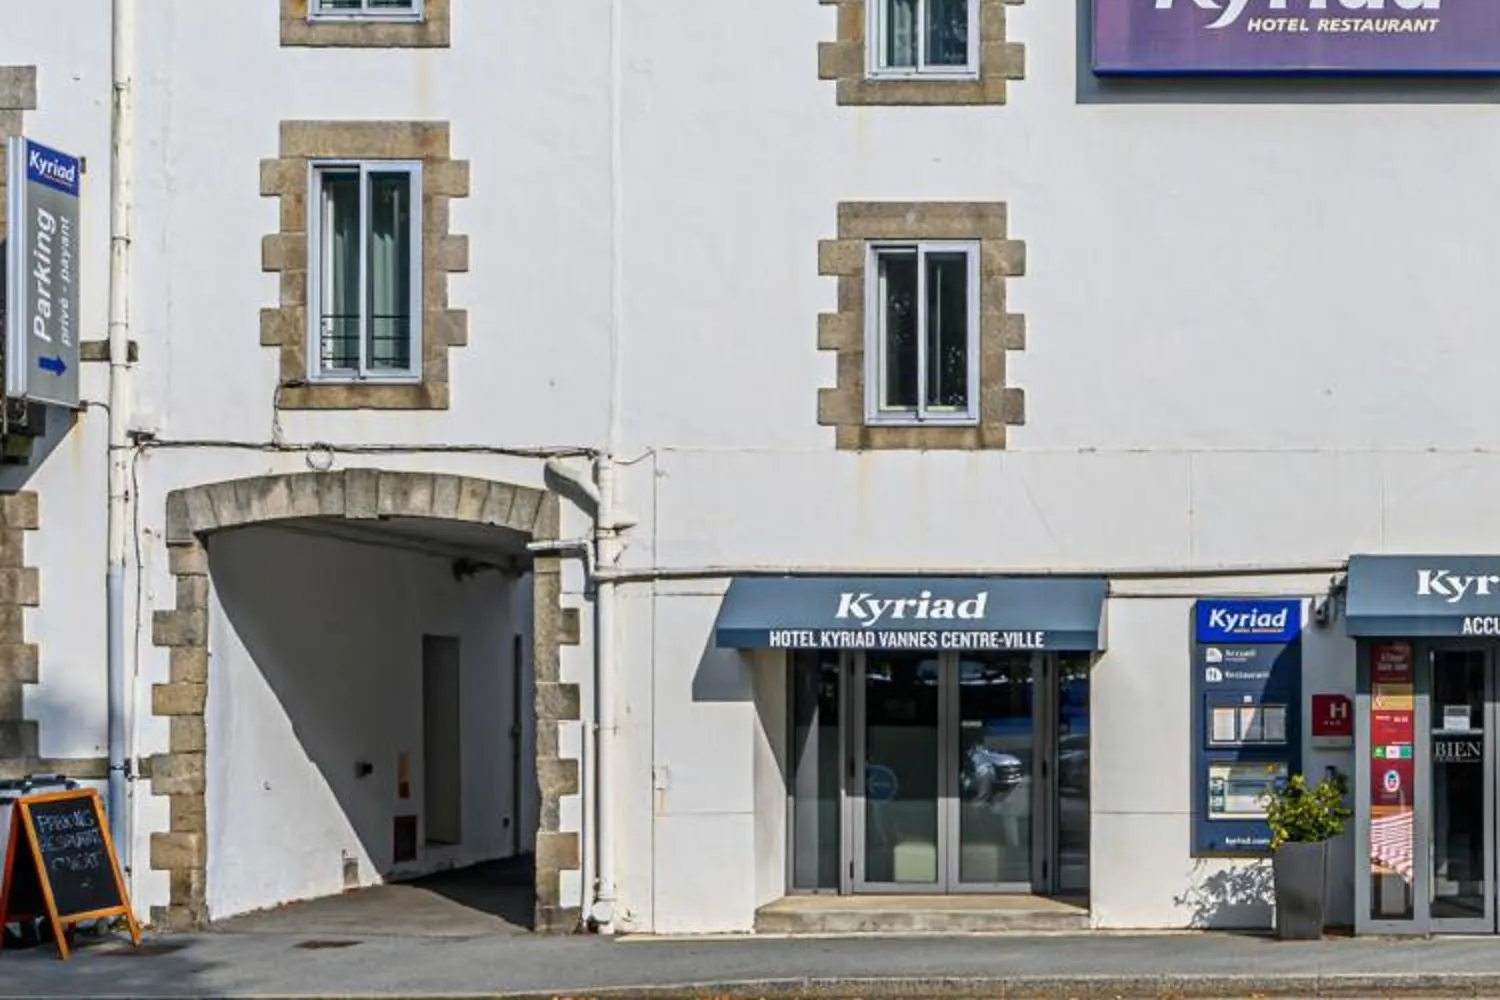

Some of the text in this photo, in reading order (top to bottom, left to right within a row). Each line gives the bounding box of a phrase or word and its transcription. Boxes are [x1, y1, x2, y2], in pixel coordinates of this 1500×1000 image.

[1247, 18, 1440, 33] HOTEL RESTAURANT
[29, 149, 75, 183] Kyriad
[59, 216, 72, 283] payant
[33, 207, 56, 344] Parking
[834, 590, 990, 628] Kyriad
[1209, 608, 1289, 633] Kyriad
[769, 630, 1044, 649] HOTEL KYRIAD VANNES CENTRE-VILLE
[1330, 702, 1347, 718] H
[1435, 741, 1481, 757] BIEN
